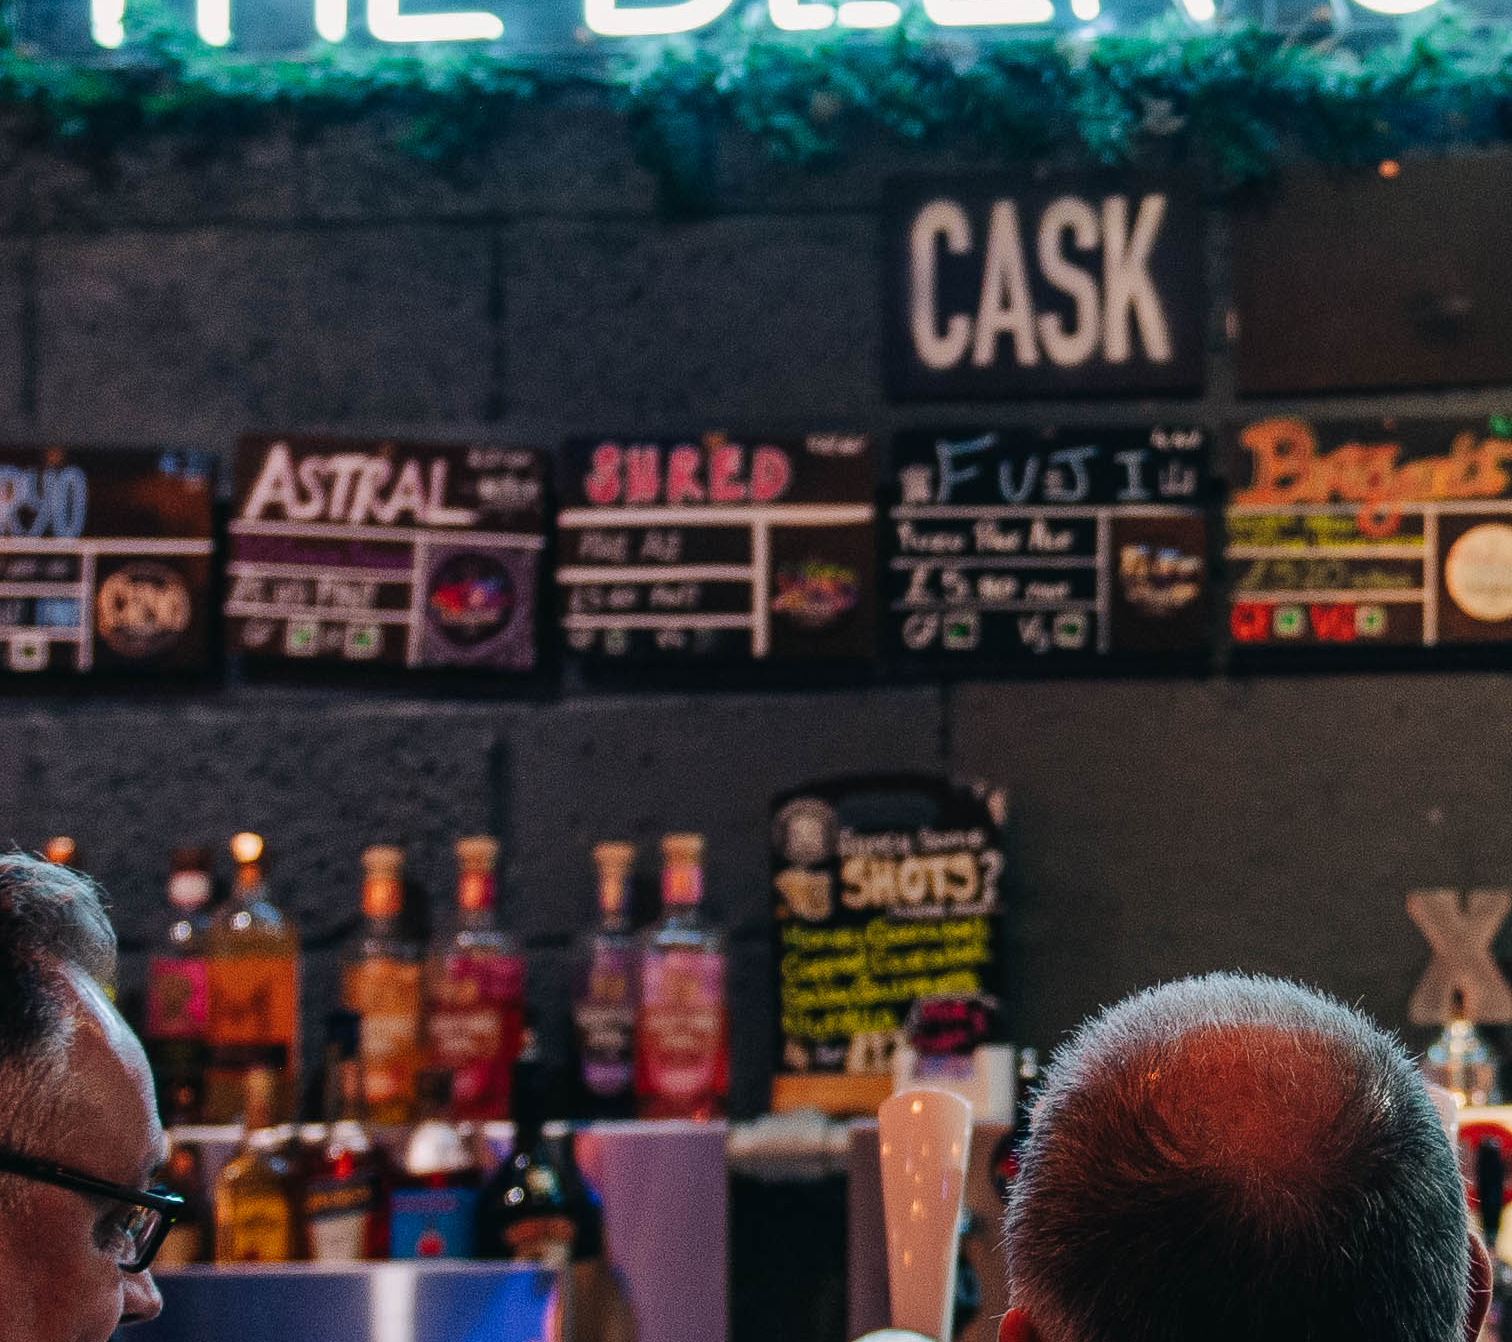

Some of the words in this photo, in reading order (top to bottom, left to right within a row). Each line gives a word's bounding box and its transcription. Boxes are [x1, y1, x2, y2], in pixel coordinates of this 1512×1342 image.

[910, 194, 1171, 369] CASK
[244, 442, 476, 525] ASTRAL
[587, 444, 790, 506] SHRED
[935, 435, 1152, 503] FUJI
